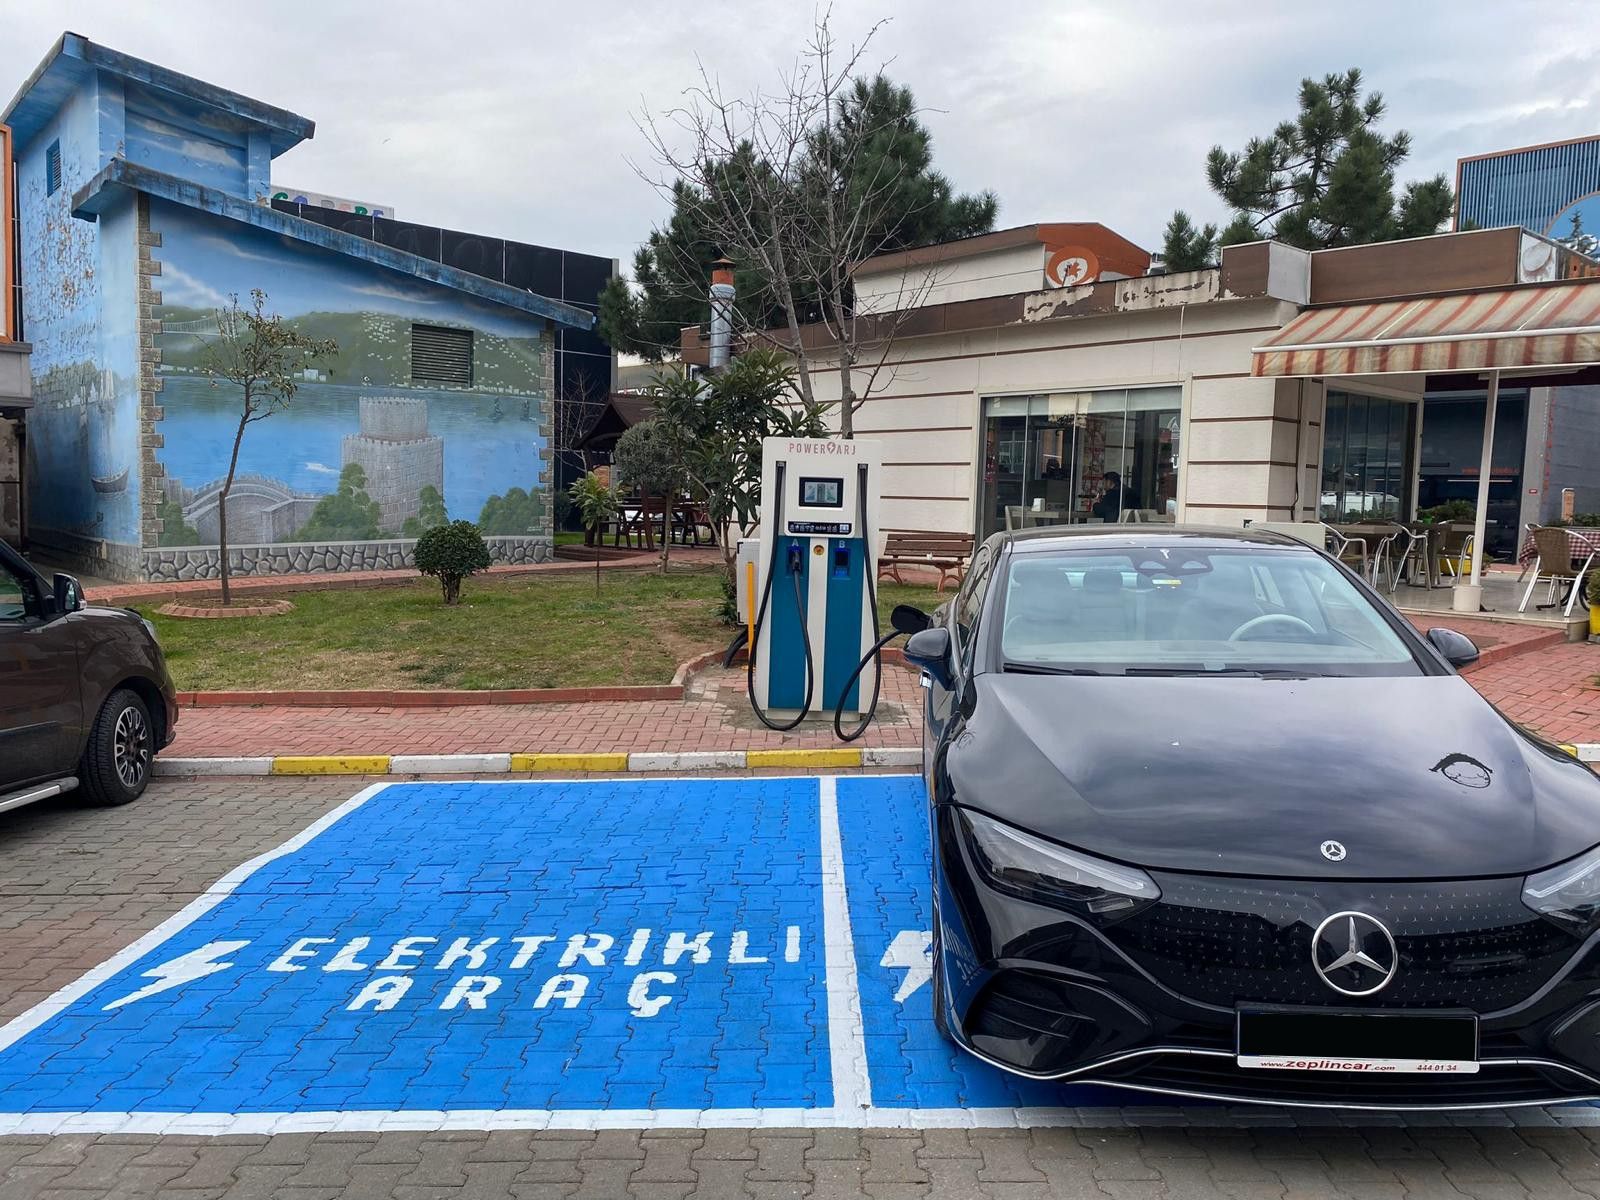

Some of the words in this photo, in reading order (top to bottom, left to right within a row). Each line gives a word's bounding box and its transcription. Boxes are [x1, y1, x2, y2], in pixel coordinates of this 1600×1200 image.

[791, 538, 799, 547] A
[838, 540, 846, 548] B
[346, 971, 677, 1018] ARAÇ
[1260, 1060, 1395, 1071] www.zeplincar.com
